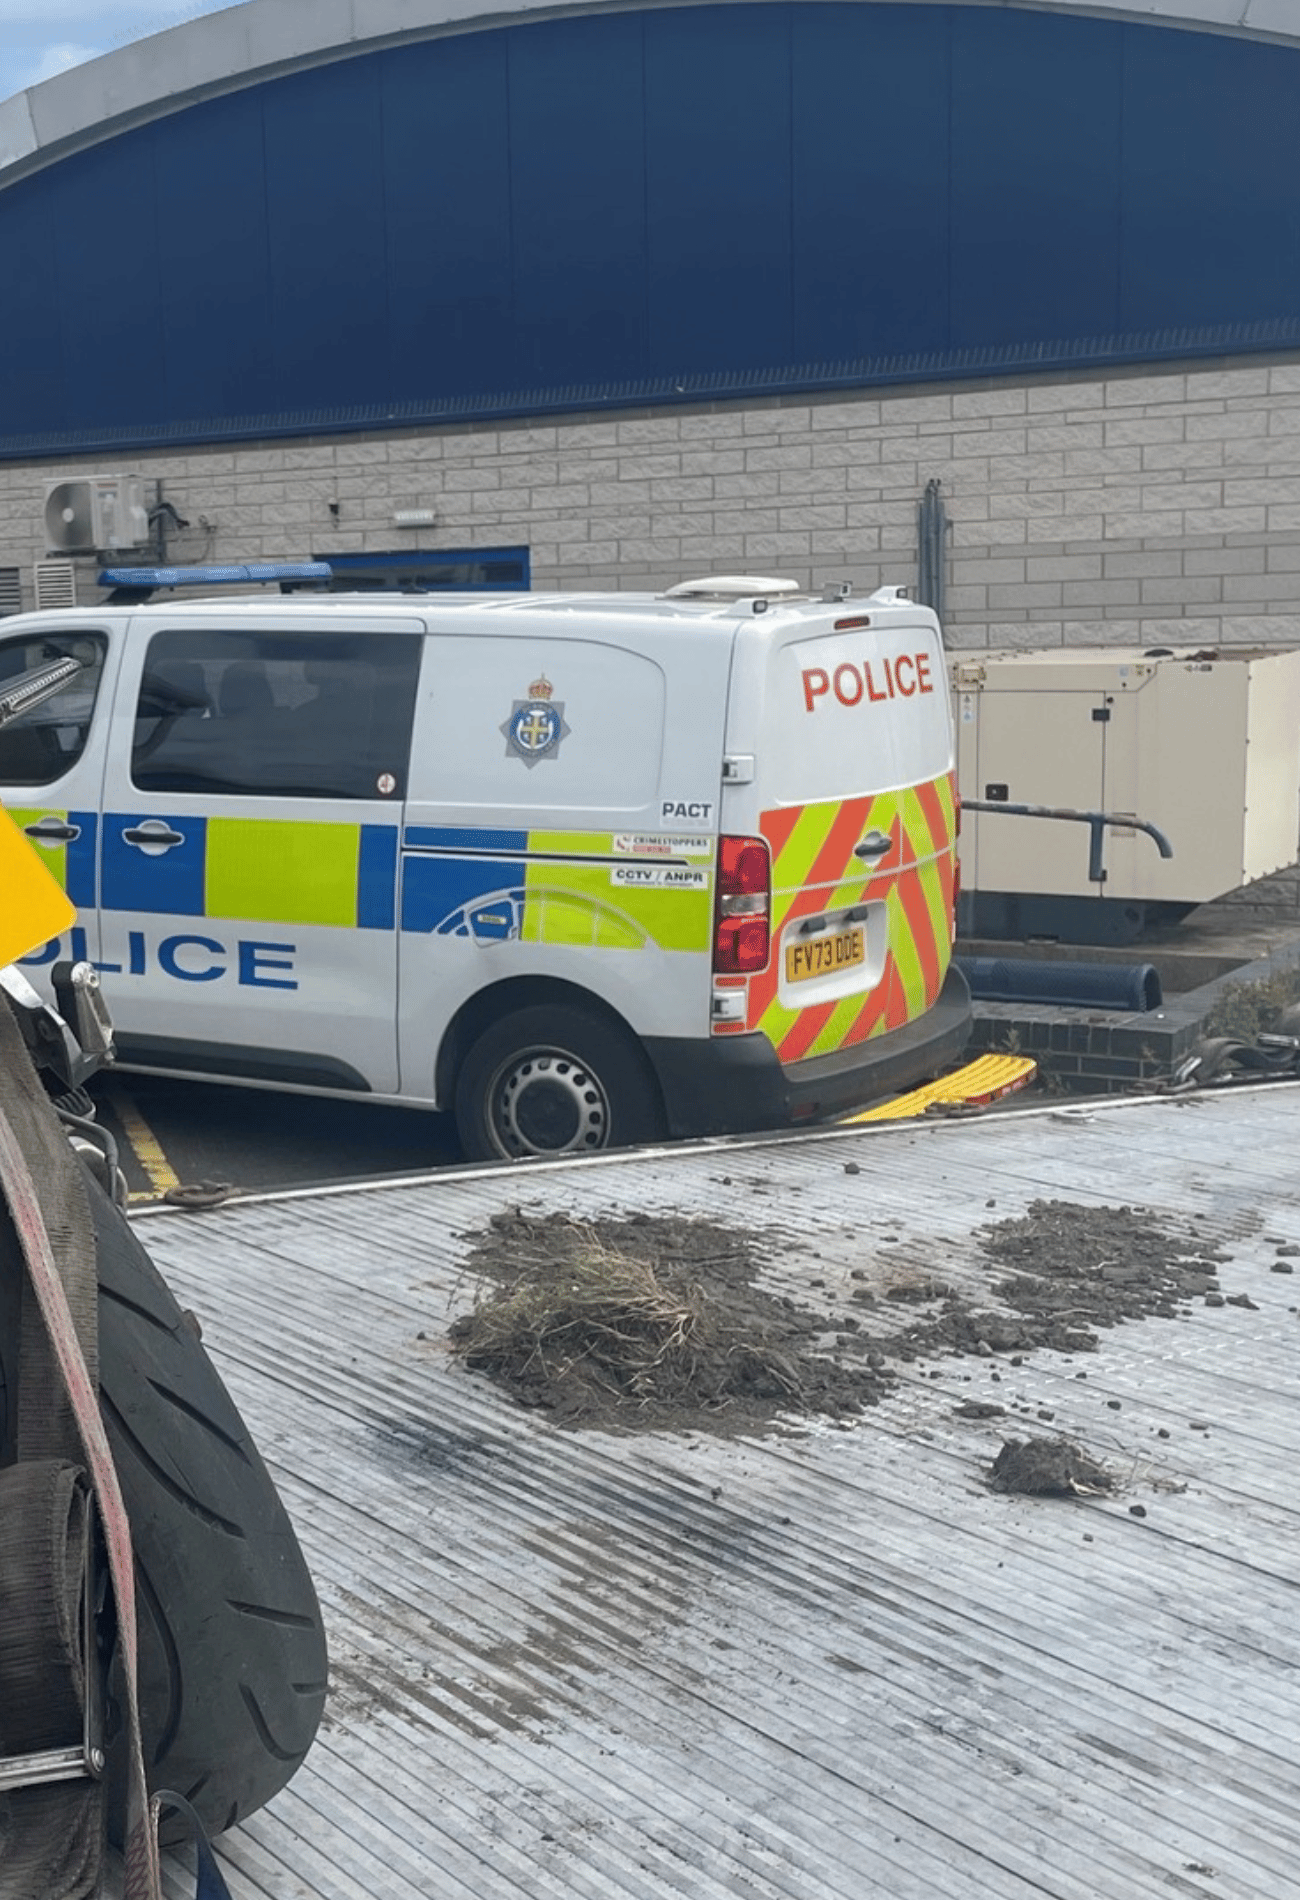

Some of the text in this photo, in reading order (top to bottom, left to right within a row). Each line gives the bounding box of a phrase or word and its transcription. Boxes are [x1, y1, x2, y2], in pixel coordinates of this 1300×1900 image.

[801, 653, 934, 713] POLICE
[661, 802, 712, 818] PACT
[633, 836, 708, 847] CRIMESTOPPERS
[616, 869, 652, 880] CCTV
[664, 871, 703, 882] ANPR
[15, 926, 299, 990] LICE
[793, 940, 833, 975] FV73
